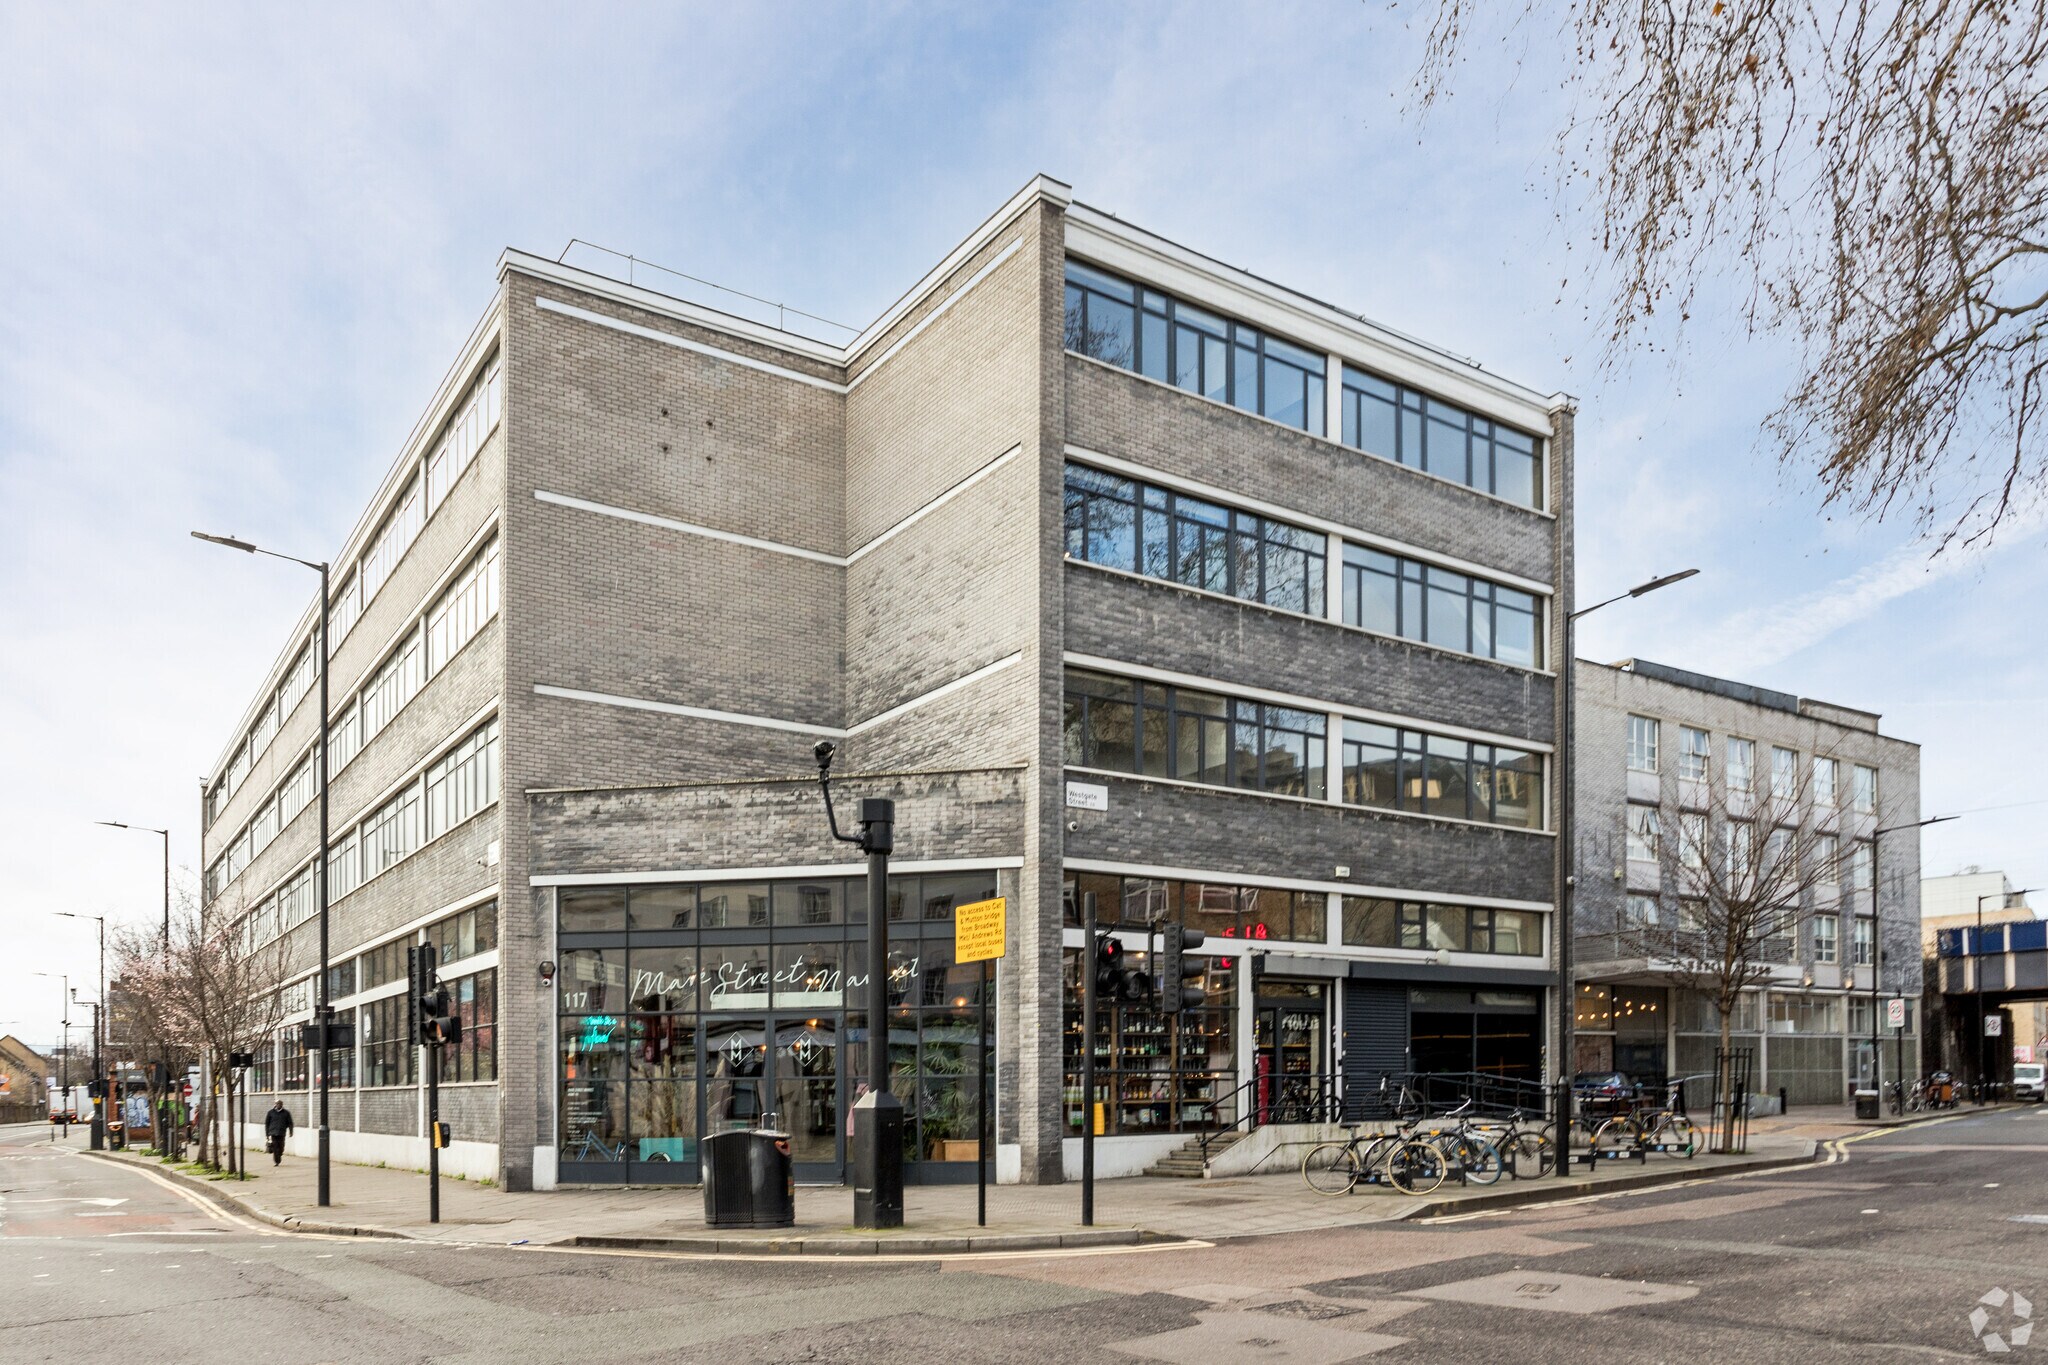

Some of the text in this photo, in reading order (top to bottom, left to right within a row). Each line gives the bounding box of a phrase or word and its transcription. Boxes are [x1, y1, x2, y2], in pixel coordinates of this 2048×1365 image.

[1069, 791, 1097, 800] Westgate
[1069, 797, 1088, 807] Street
[967, 906, 984, 915] access
[961, 922, 999, 933] from Broadway
[972, 931, 993, 940] Andrews
[958, 942, 974, 951] except
[988, 938, 1003, 946] buses
[967, 948, 993, 958] and cycles
[629, 968, 712, 1004] Mare
[709, 953, 807, 1002] Street
[564, 991, 588, 1008] 117
